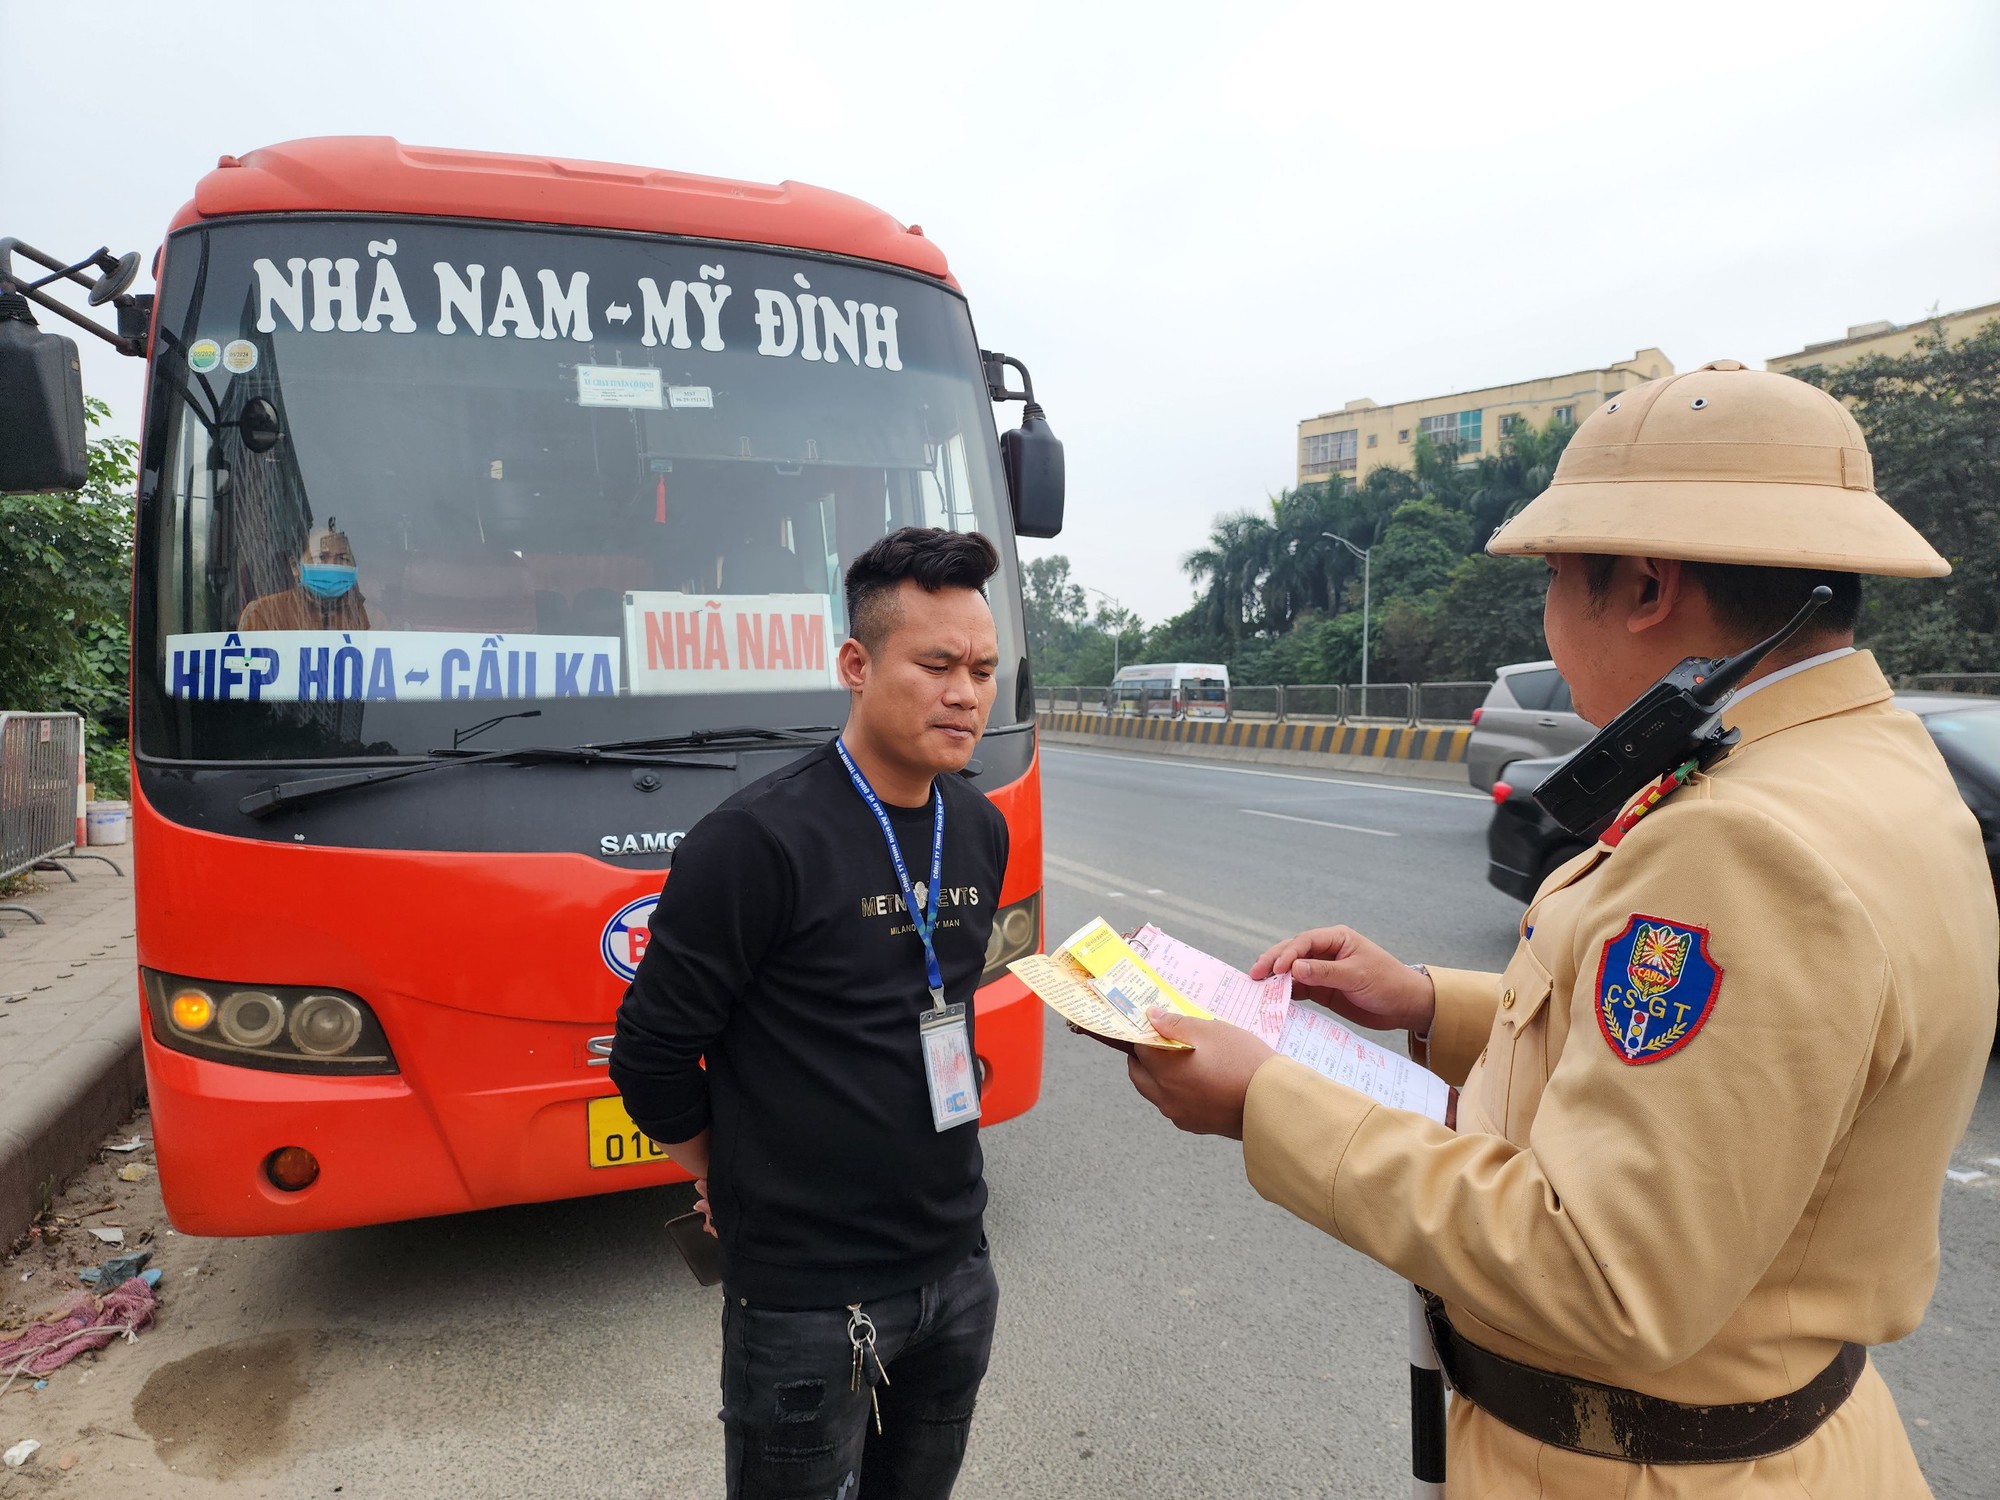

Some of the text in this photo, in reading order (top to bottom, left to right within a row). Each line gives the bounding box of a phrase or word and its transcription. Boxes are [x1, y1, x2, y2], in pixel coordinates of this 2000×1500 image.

[253, 238, 903, 371] NHÃ NAM MỸ ĐÌNH
[643, 600, 825, 671] NHÃ NAM
[298, 634, 397, 702] HÒA
[942, 919, 960, 928] MAN
[1637, 967, 1665, 983] CAND
[1607, 985, 1691, 1023] CSGT
